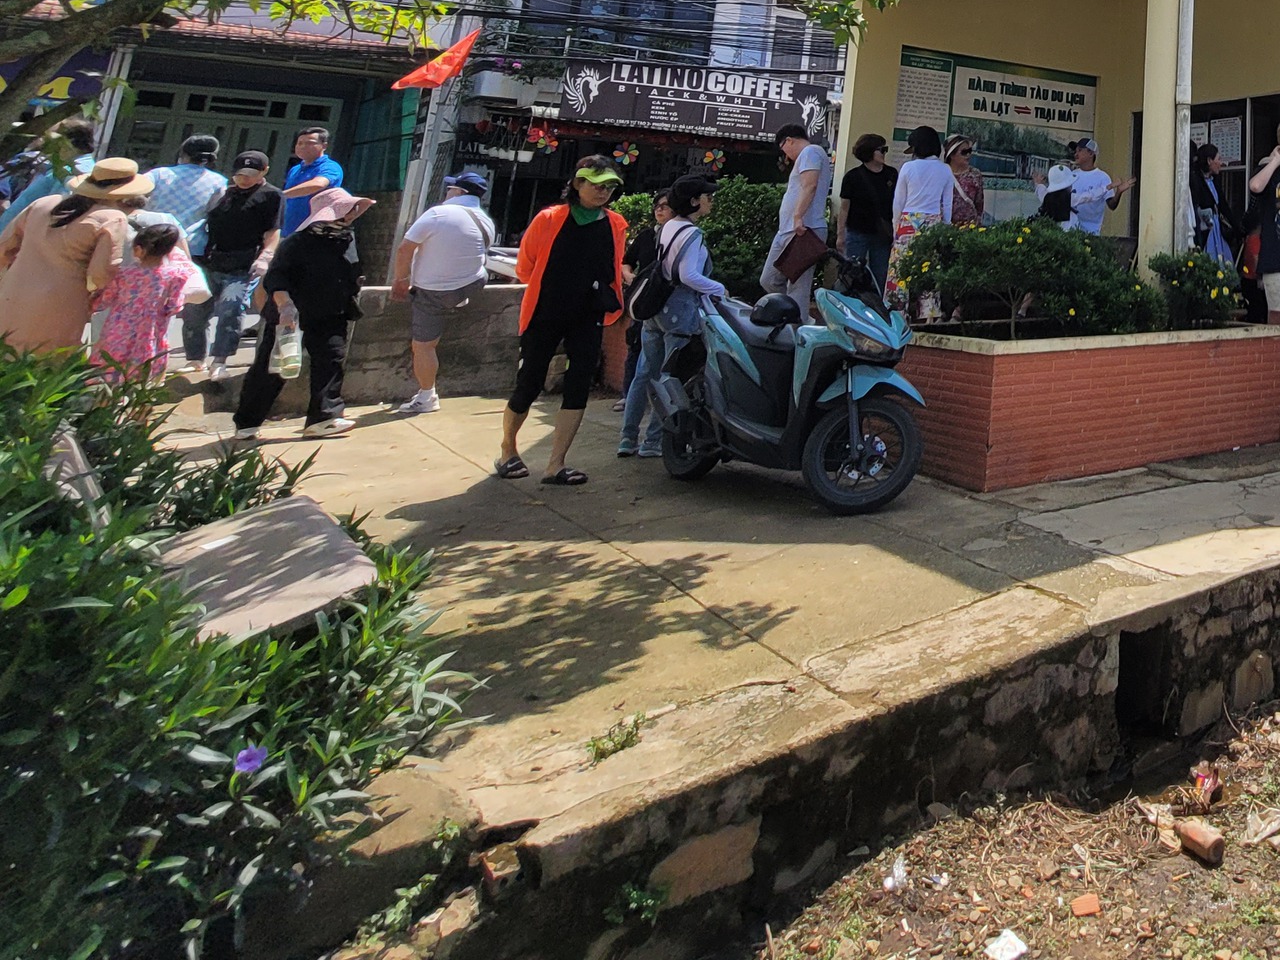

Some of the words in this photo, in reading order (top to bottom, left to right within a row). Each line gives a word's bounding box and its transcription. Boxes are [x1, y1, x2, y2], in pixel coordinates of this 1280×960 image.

[612, 63, 704, 91] LATINO
[706, 72, 795, 101] COFFEE
[968, 76, 996, 93] HÀNH
[1000, 81, 1027, 98] TRÌNH
[1030, 85, 1049, 101] TÀU
[1051, 89, 1063, 103] DU
[1066, 93, 1085, 107] LỊCH
[973, 97, 987, 112] ĐÀ
[991, 101, 1010, 117] LẠT
[1035, 106, 1055, 123] TRẠI
[1058, 108, 1079, 123] MÁT
